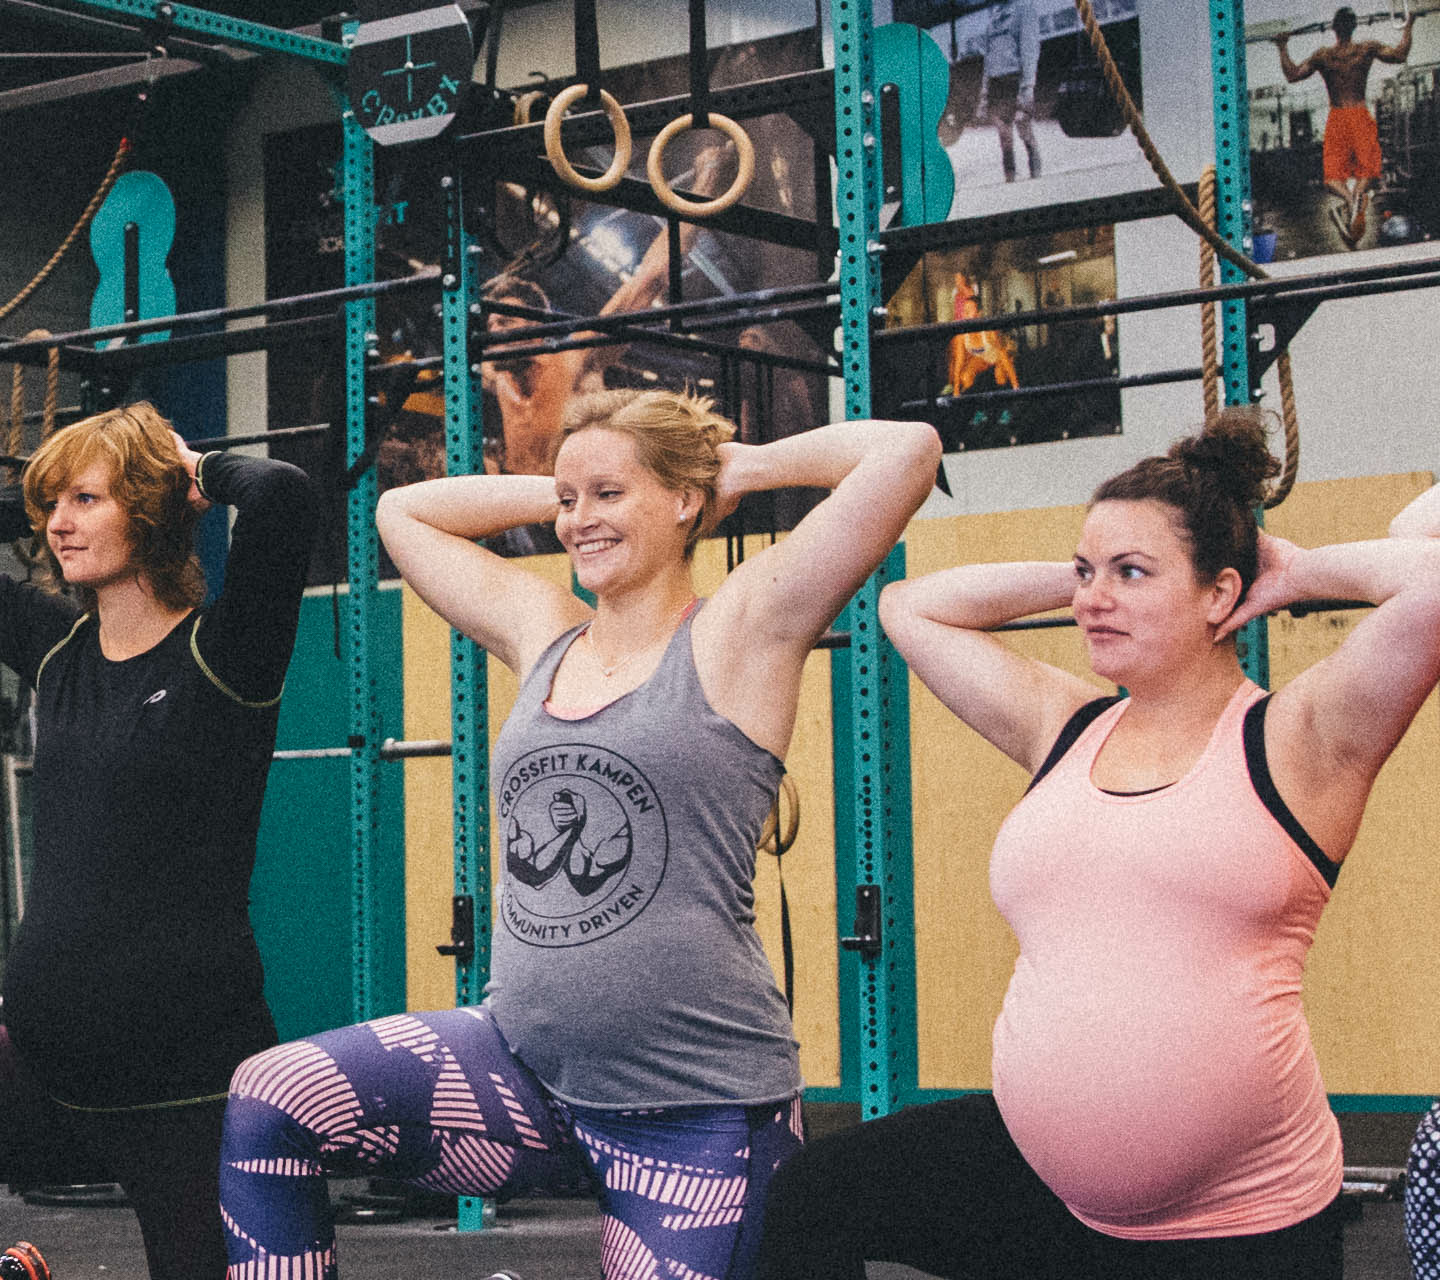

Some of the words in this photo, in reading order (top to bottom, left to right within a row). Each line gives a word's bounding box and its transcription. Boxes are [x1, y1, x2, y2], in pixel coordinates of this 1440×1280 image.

[500, 754, 569, 818] CROSSFIT
[576, 753, 655, 814] KAMPEN
[579, 883, 645, 935] DRIVEN
